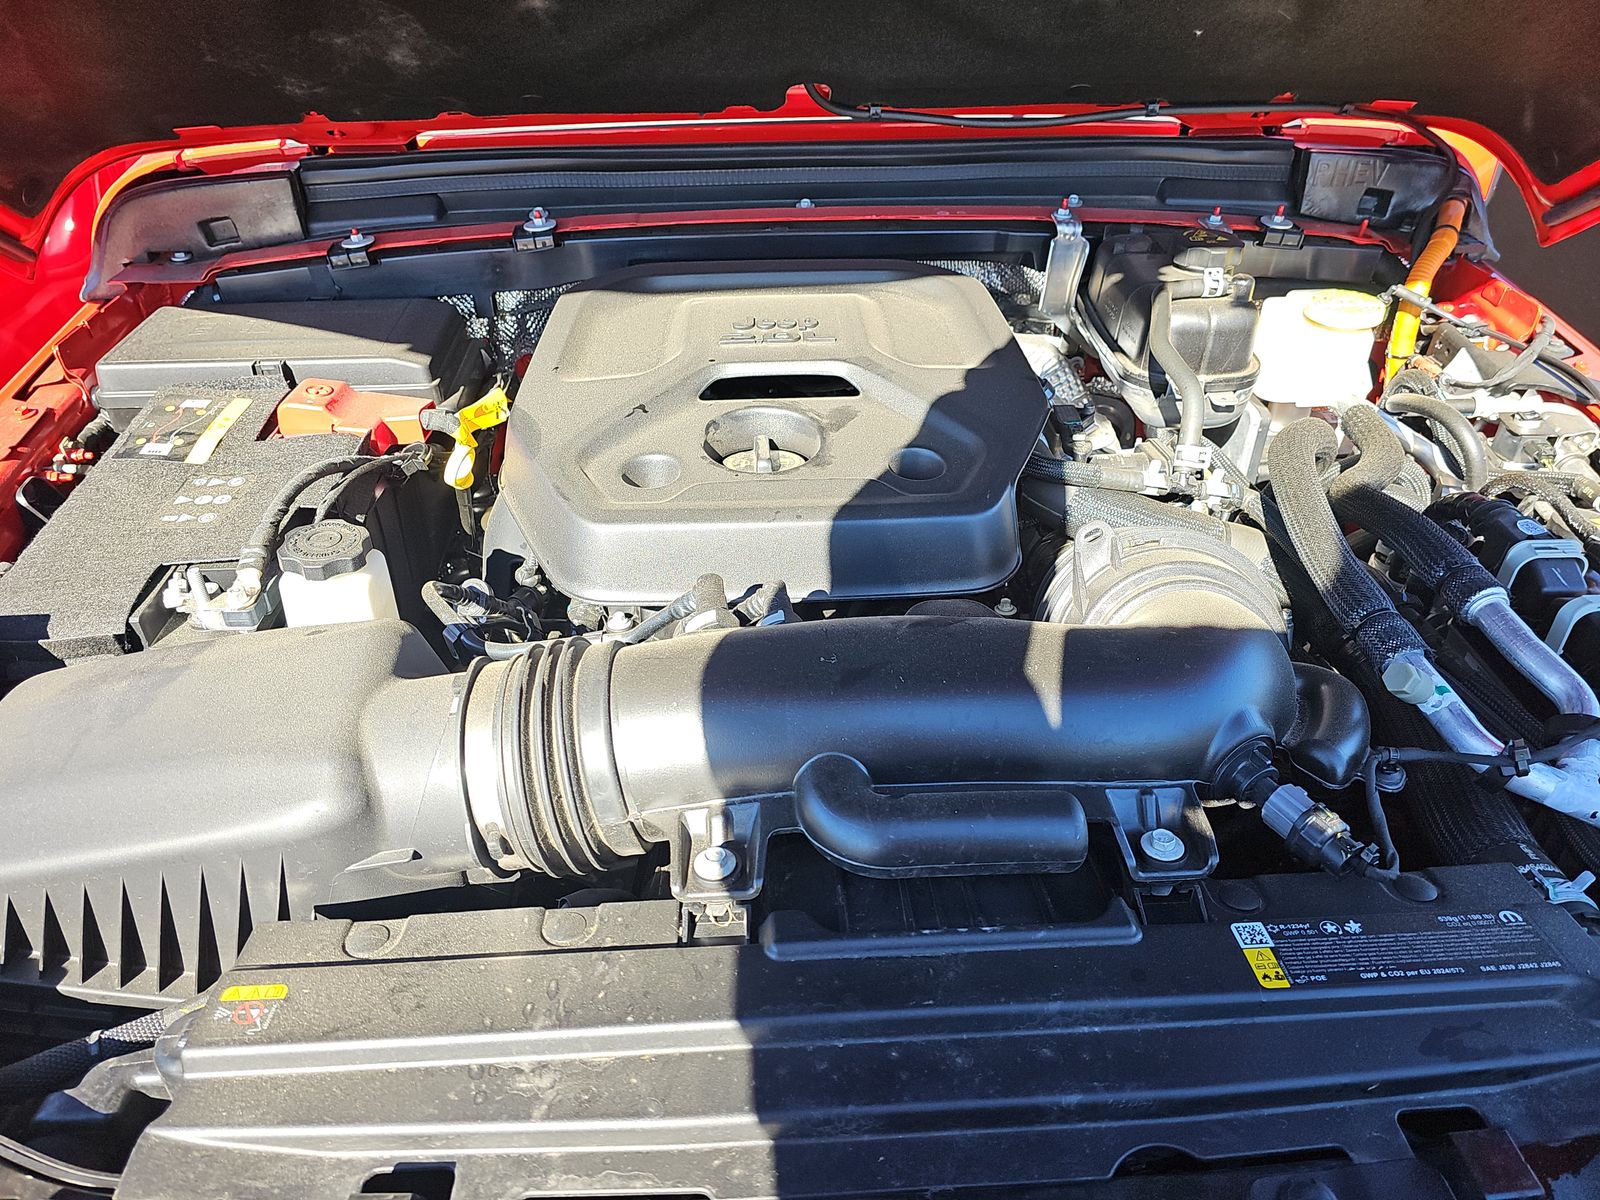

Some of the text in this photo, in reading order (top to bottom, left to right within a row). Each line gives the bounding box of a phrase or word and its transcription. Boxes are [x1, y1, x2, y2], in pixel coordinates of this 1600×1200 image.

[1311, 159, 1391, 187] PHEV
[731, 317, 820, 331] Jeep
[719, 331, 838, 345] 2.0L
